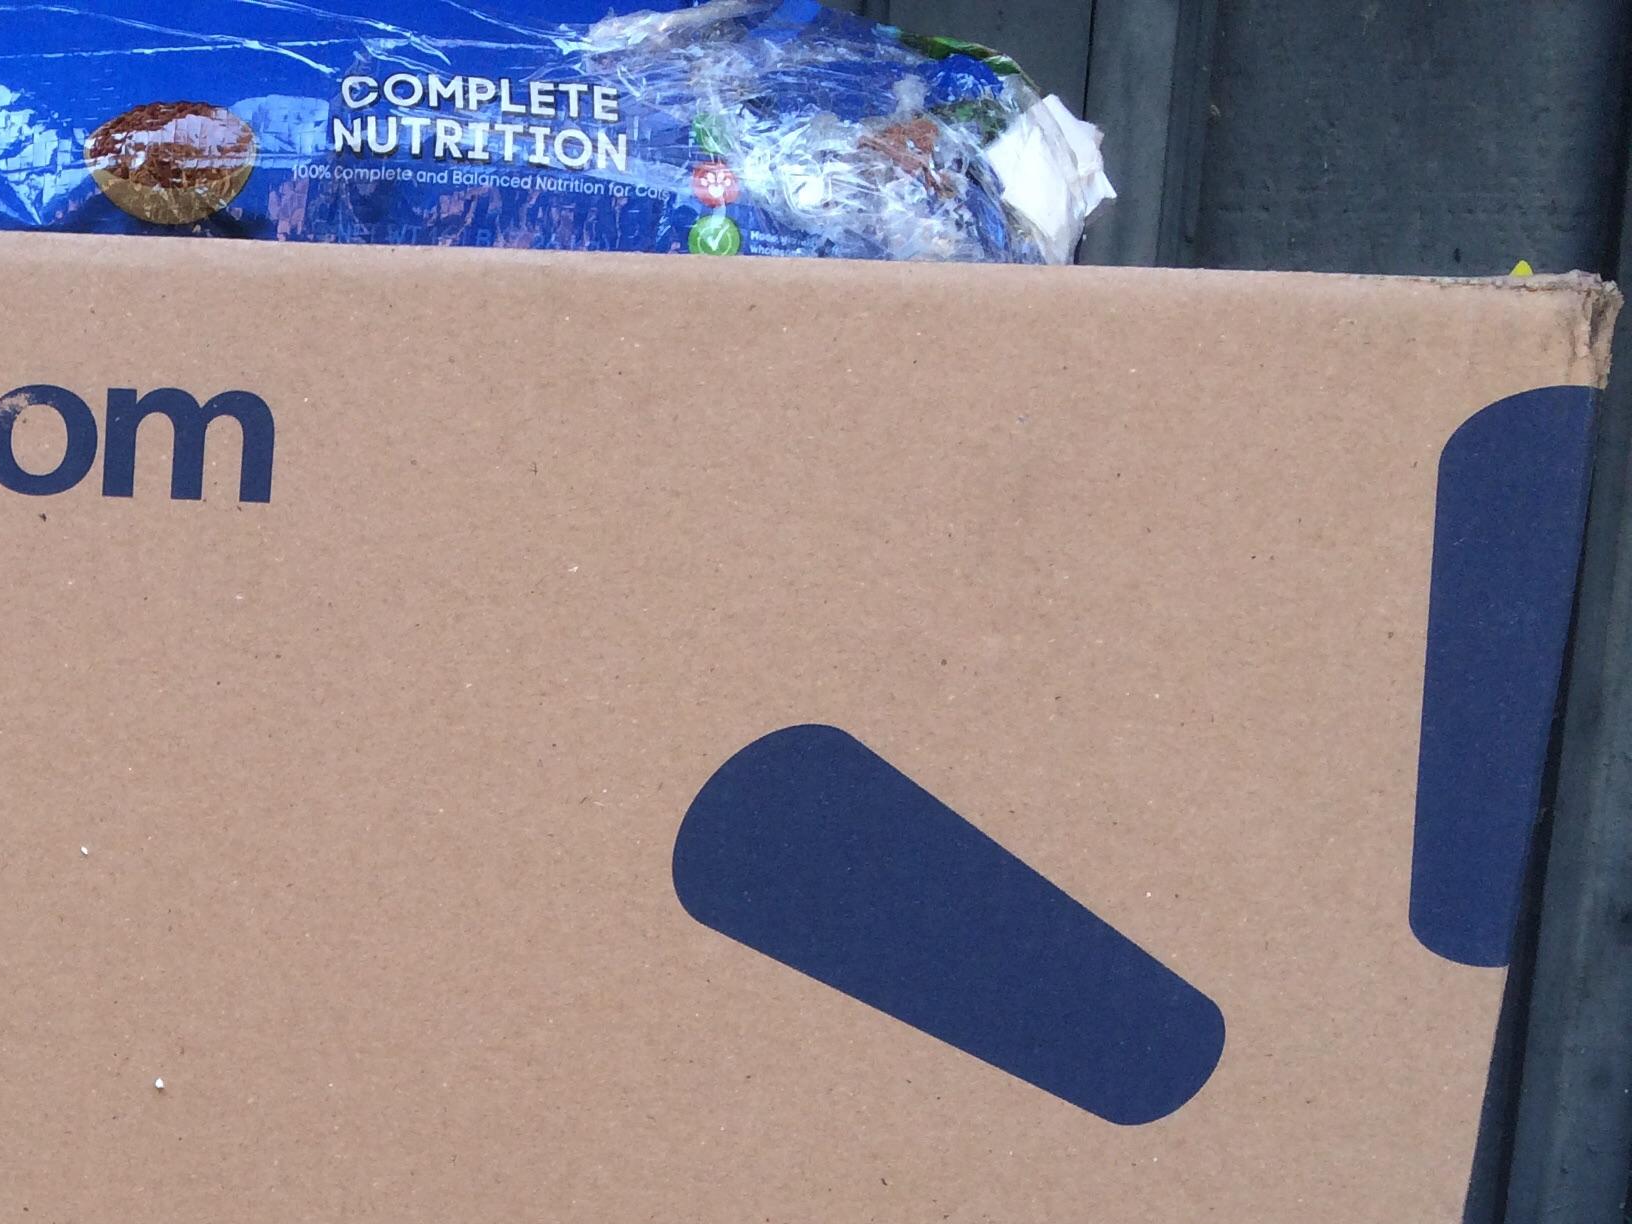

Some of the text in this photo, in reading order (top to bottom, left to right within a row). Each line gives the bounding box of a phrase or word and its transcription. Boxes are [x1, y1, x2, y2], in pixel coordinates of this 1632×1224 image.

[341, 72, 619, 122] COMPLETE
[332, 115, 629, 172] NUTRITION
[292, 164, 331, 180] 100%
[334, 165, 413, 184] Complete
[417, 169, 449, 185] and
[452, 169, 531, 190] Balanced
[536, 176, 605, 197] Nutrition
[608, 181, 631, 198] for
